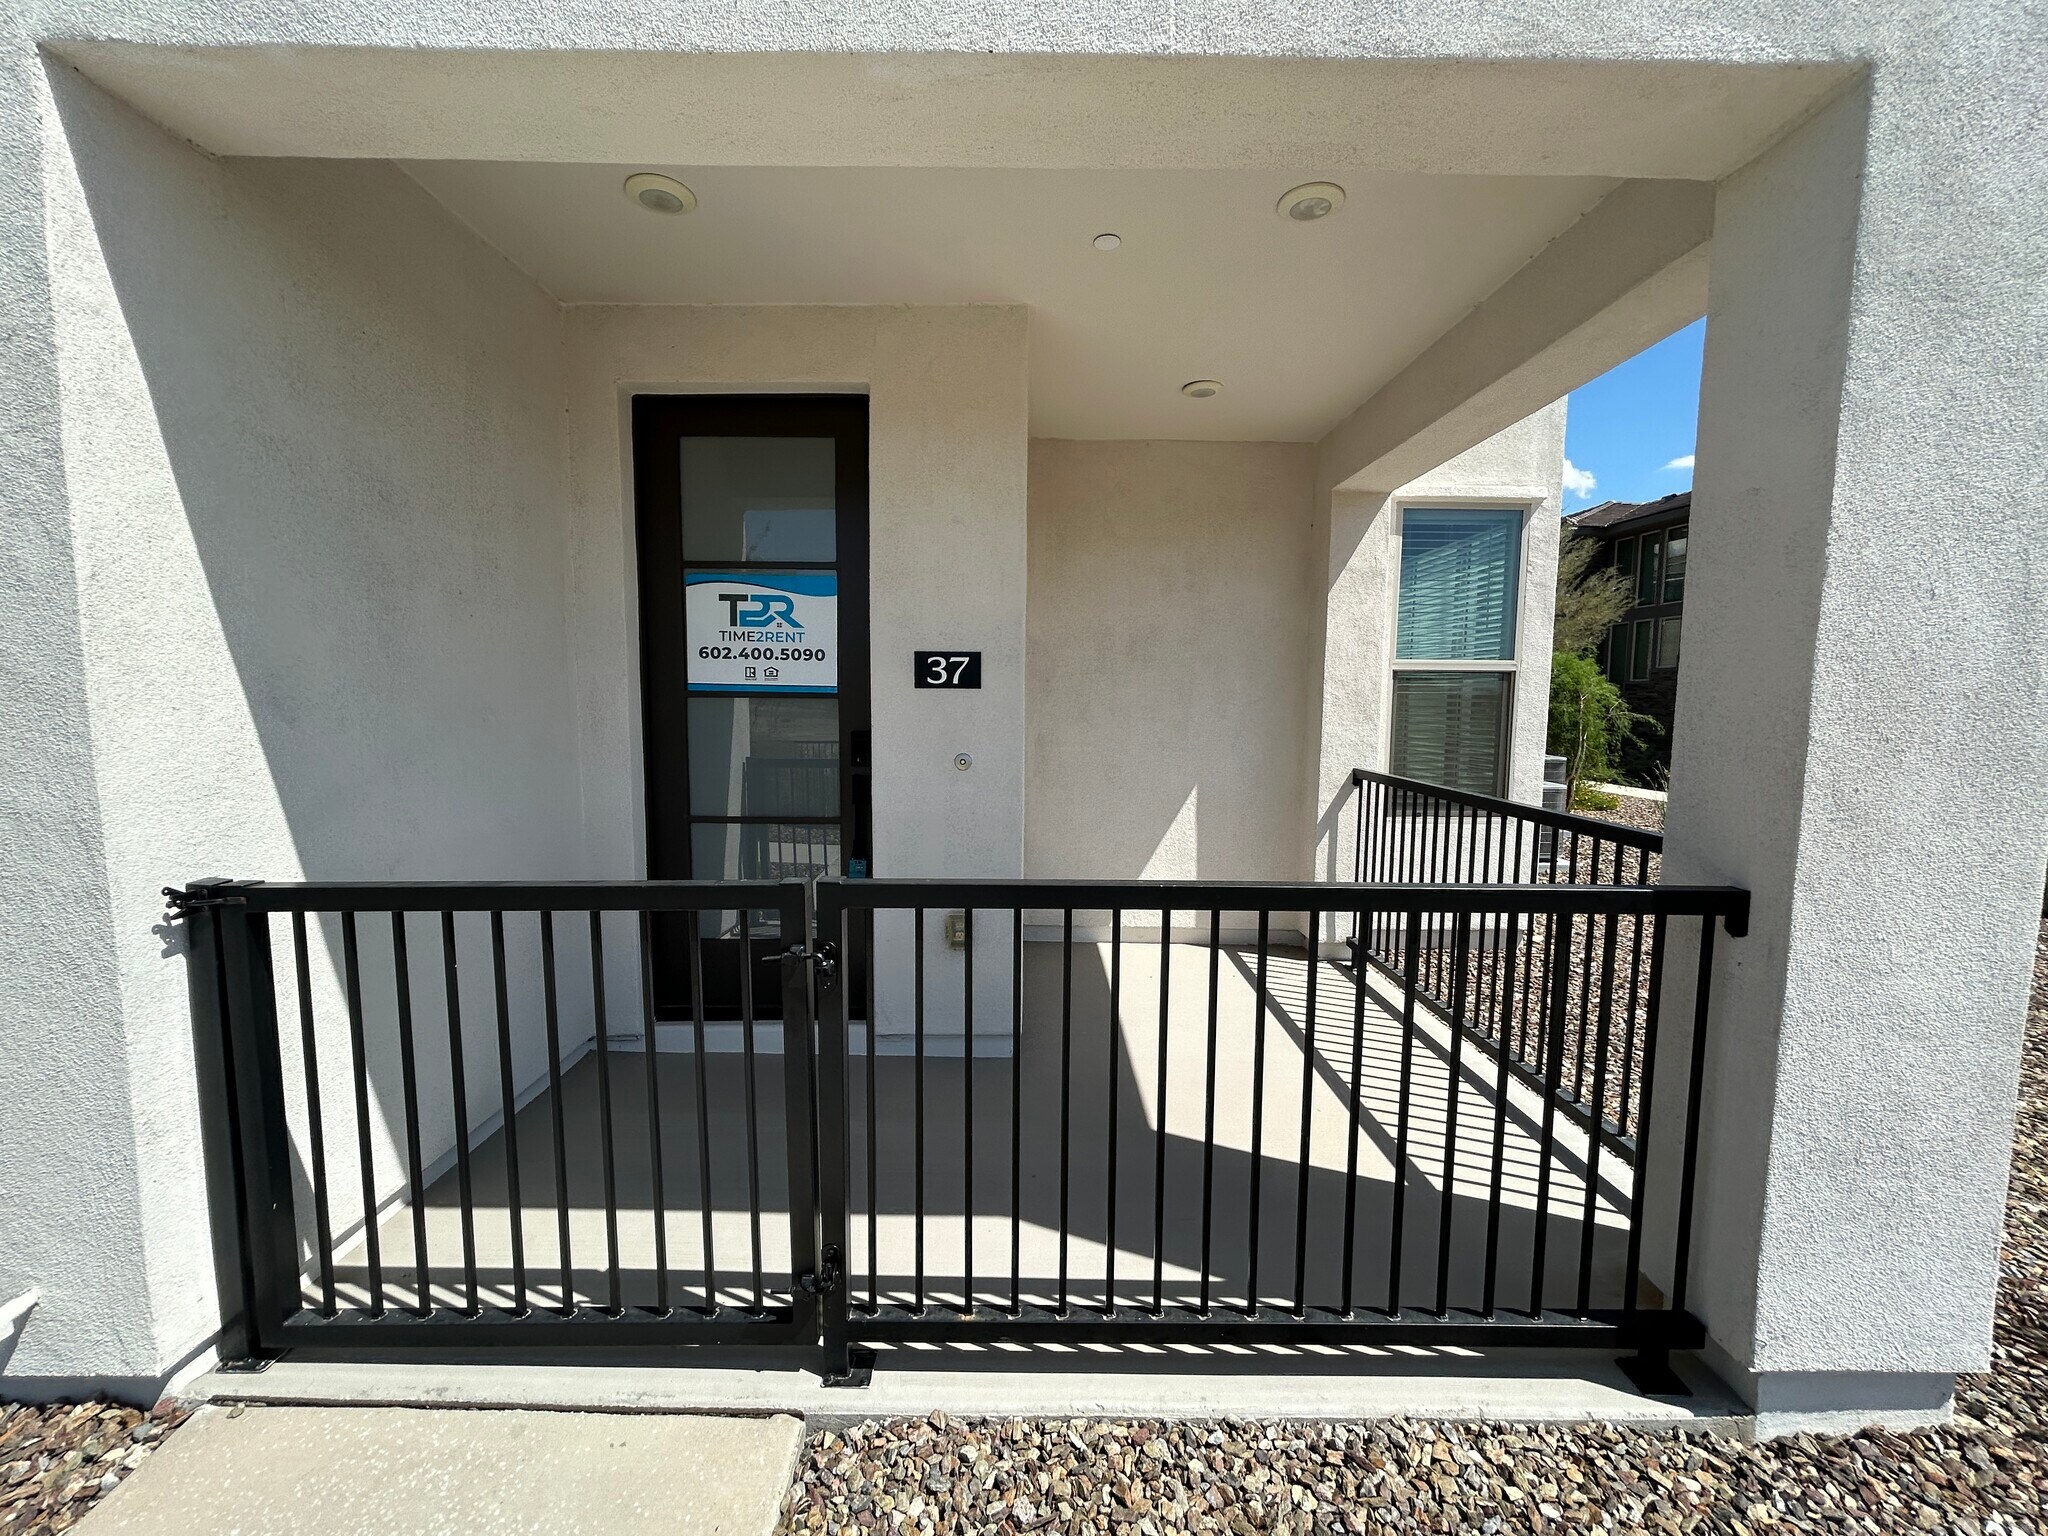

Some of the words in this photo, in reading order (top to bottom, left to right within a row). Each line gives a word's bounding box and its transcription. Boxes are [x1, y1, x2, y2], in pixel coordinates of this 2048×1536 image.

[718, 630, 805, 643] TIME2RENT
[698, 646, 826, 661] 602.400.5090
[927, 656, 970, 684] 37
